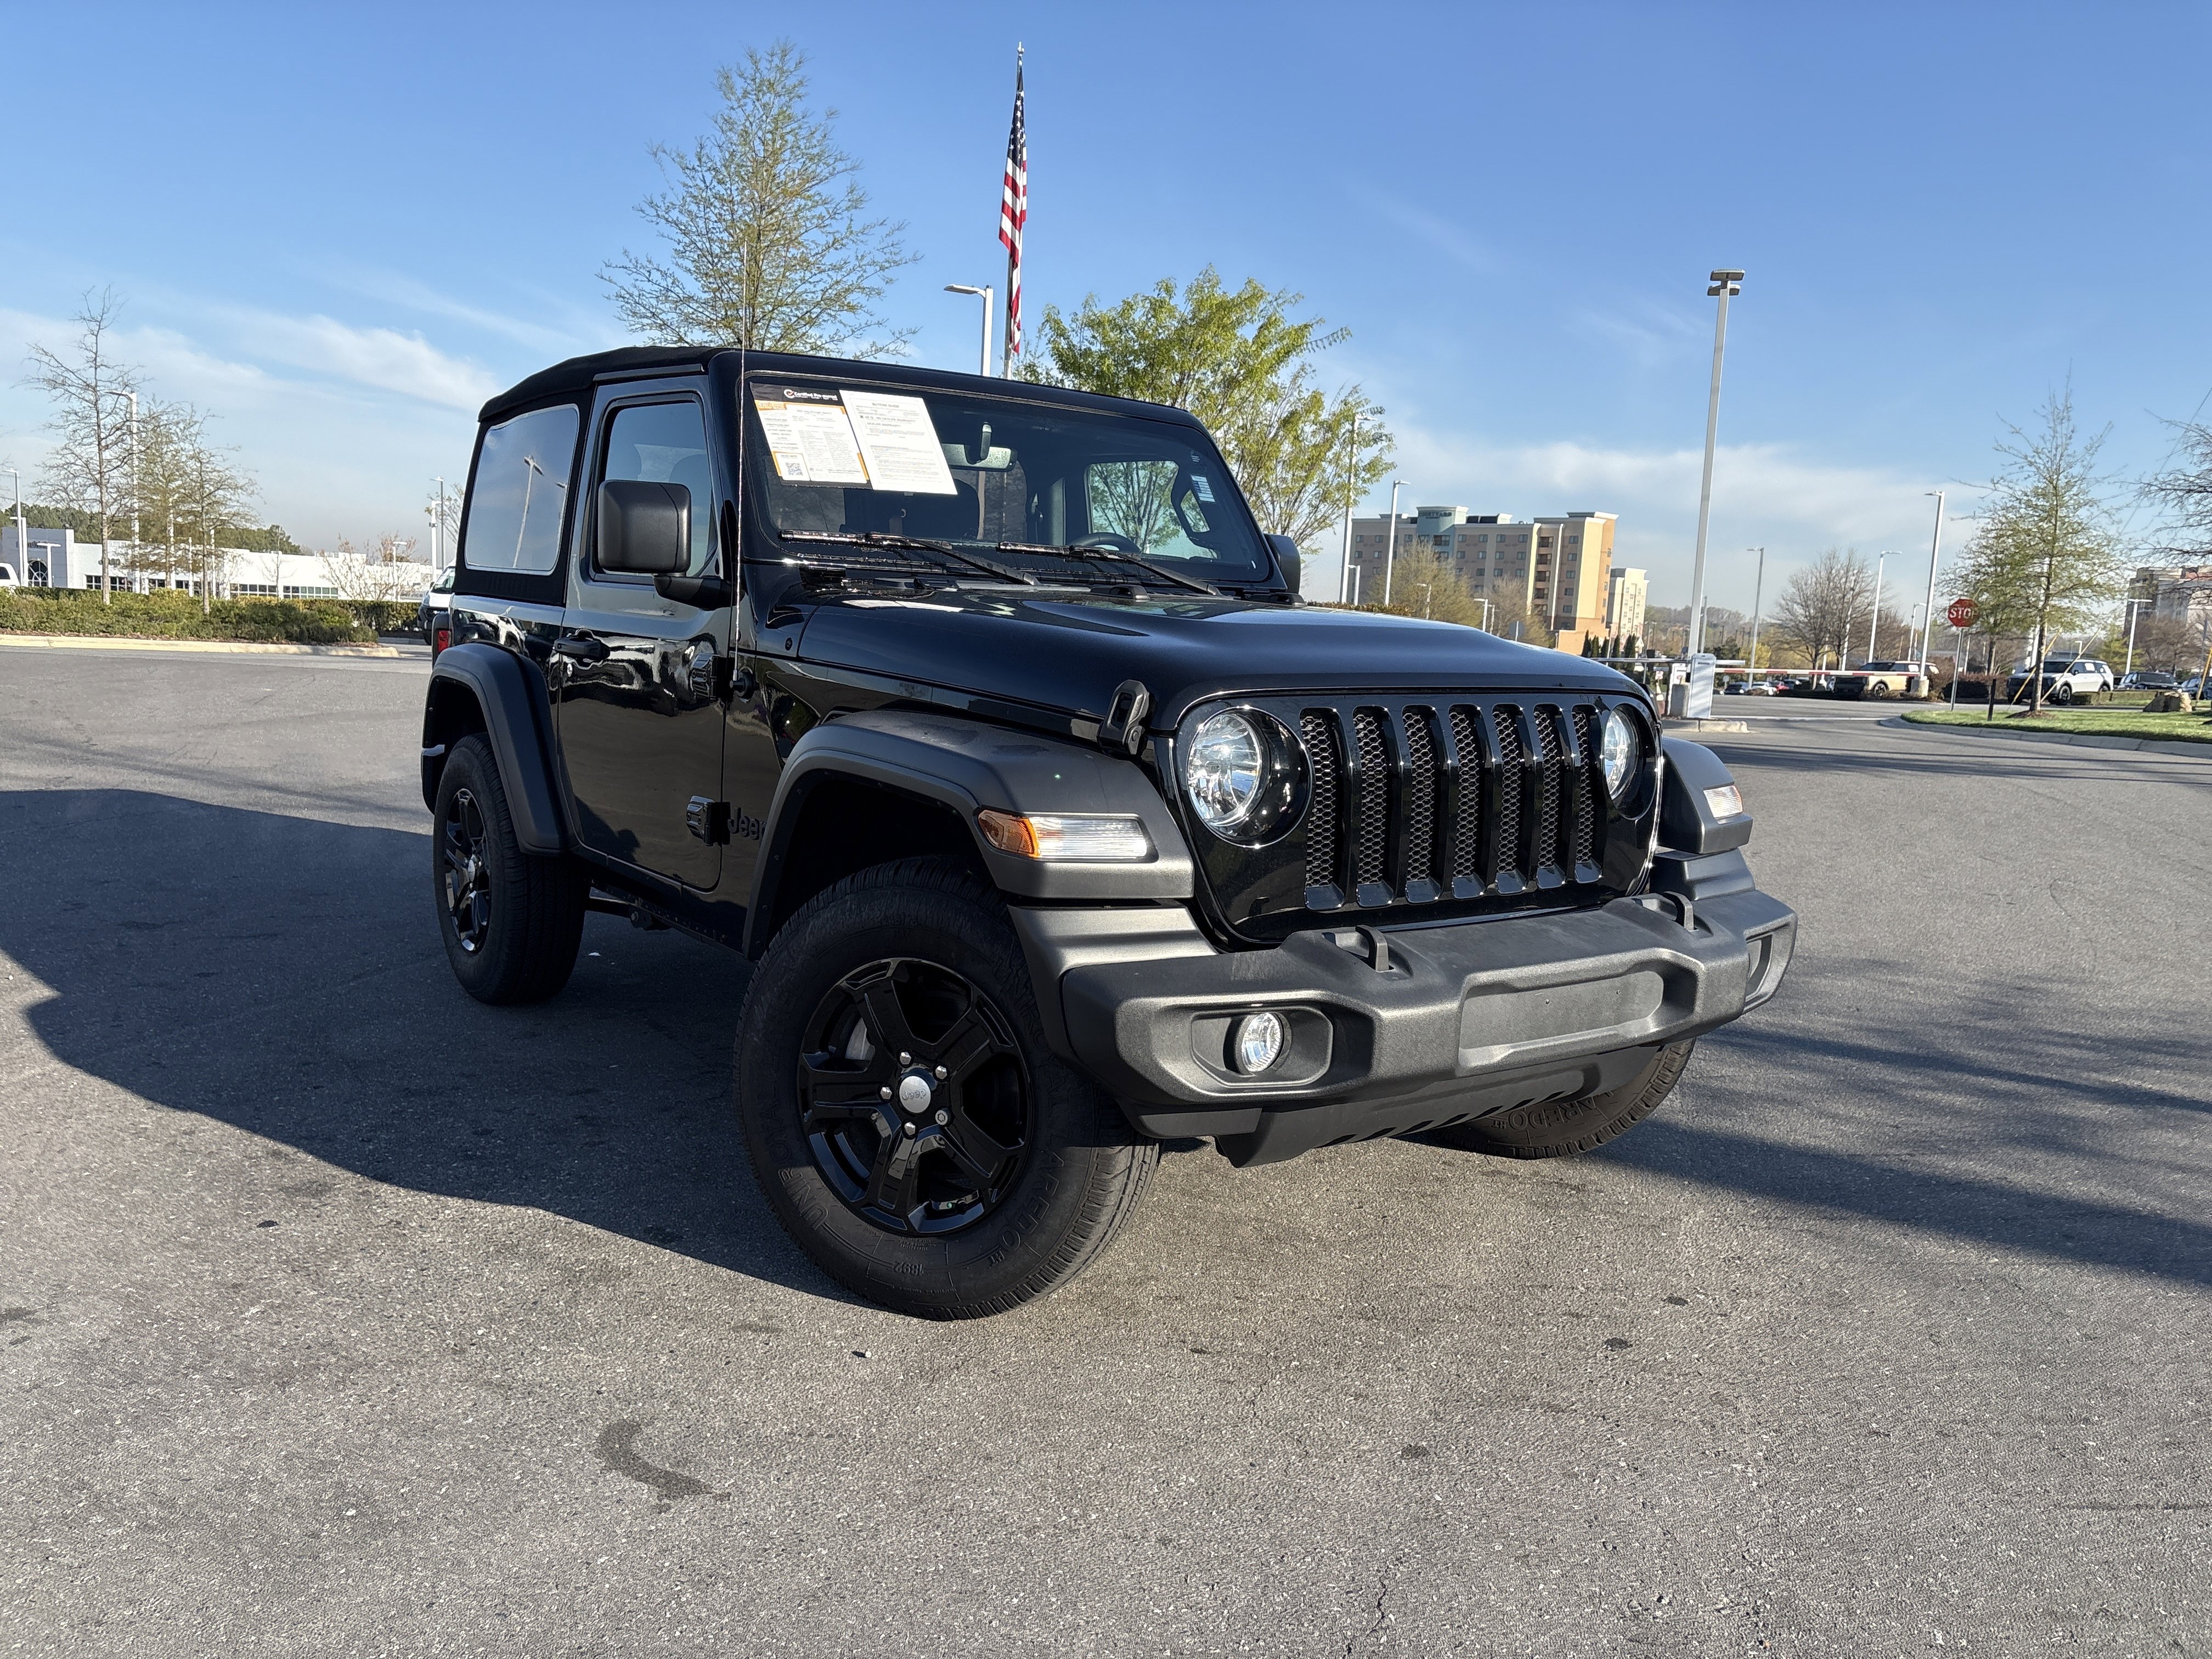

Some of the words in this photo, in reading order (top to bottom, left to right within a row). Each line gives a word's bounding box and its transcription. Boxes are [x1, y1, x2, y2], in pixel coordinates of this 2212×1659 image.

[901, 1088, 927, 1101] Jeep
[998, 1133, 1068, 1251] LAREDO
[894, 1261, 924, 1277] 1892
